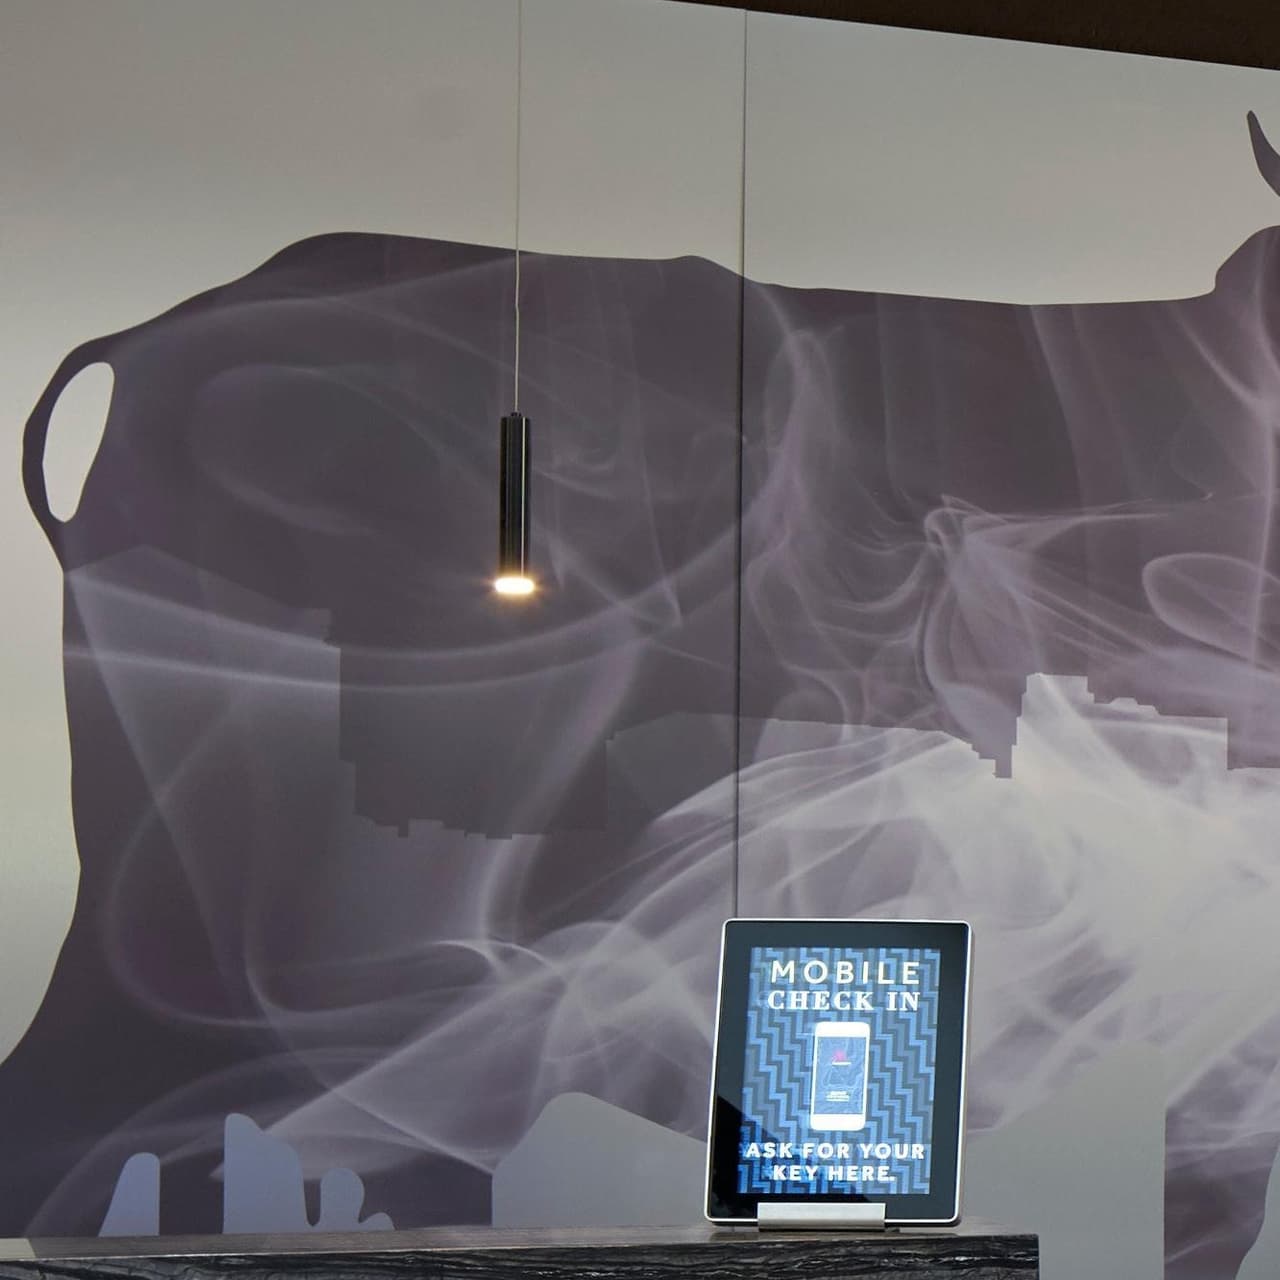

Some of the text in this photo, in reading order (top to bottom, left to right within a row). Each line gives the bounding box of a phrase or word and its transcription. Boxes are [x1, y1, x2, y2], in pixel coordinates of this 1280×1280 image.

[771, 960, 920, 985] MOBILE
[767, 990, 920, 1011] CHECK IN
[745, 1142, 925, 1160] ASK FOR YOUR
[772, 1165, 895, 1181] KEY HERE.
